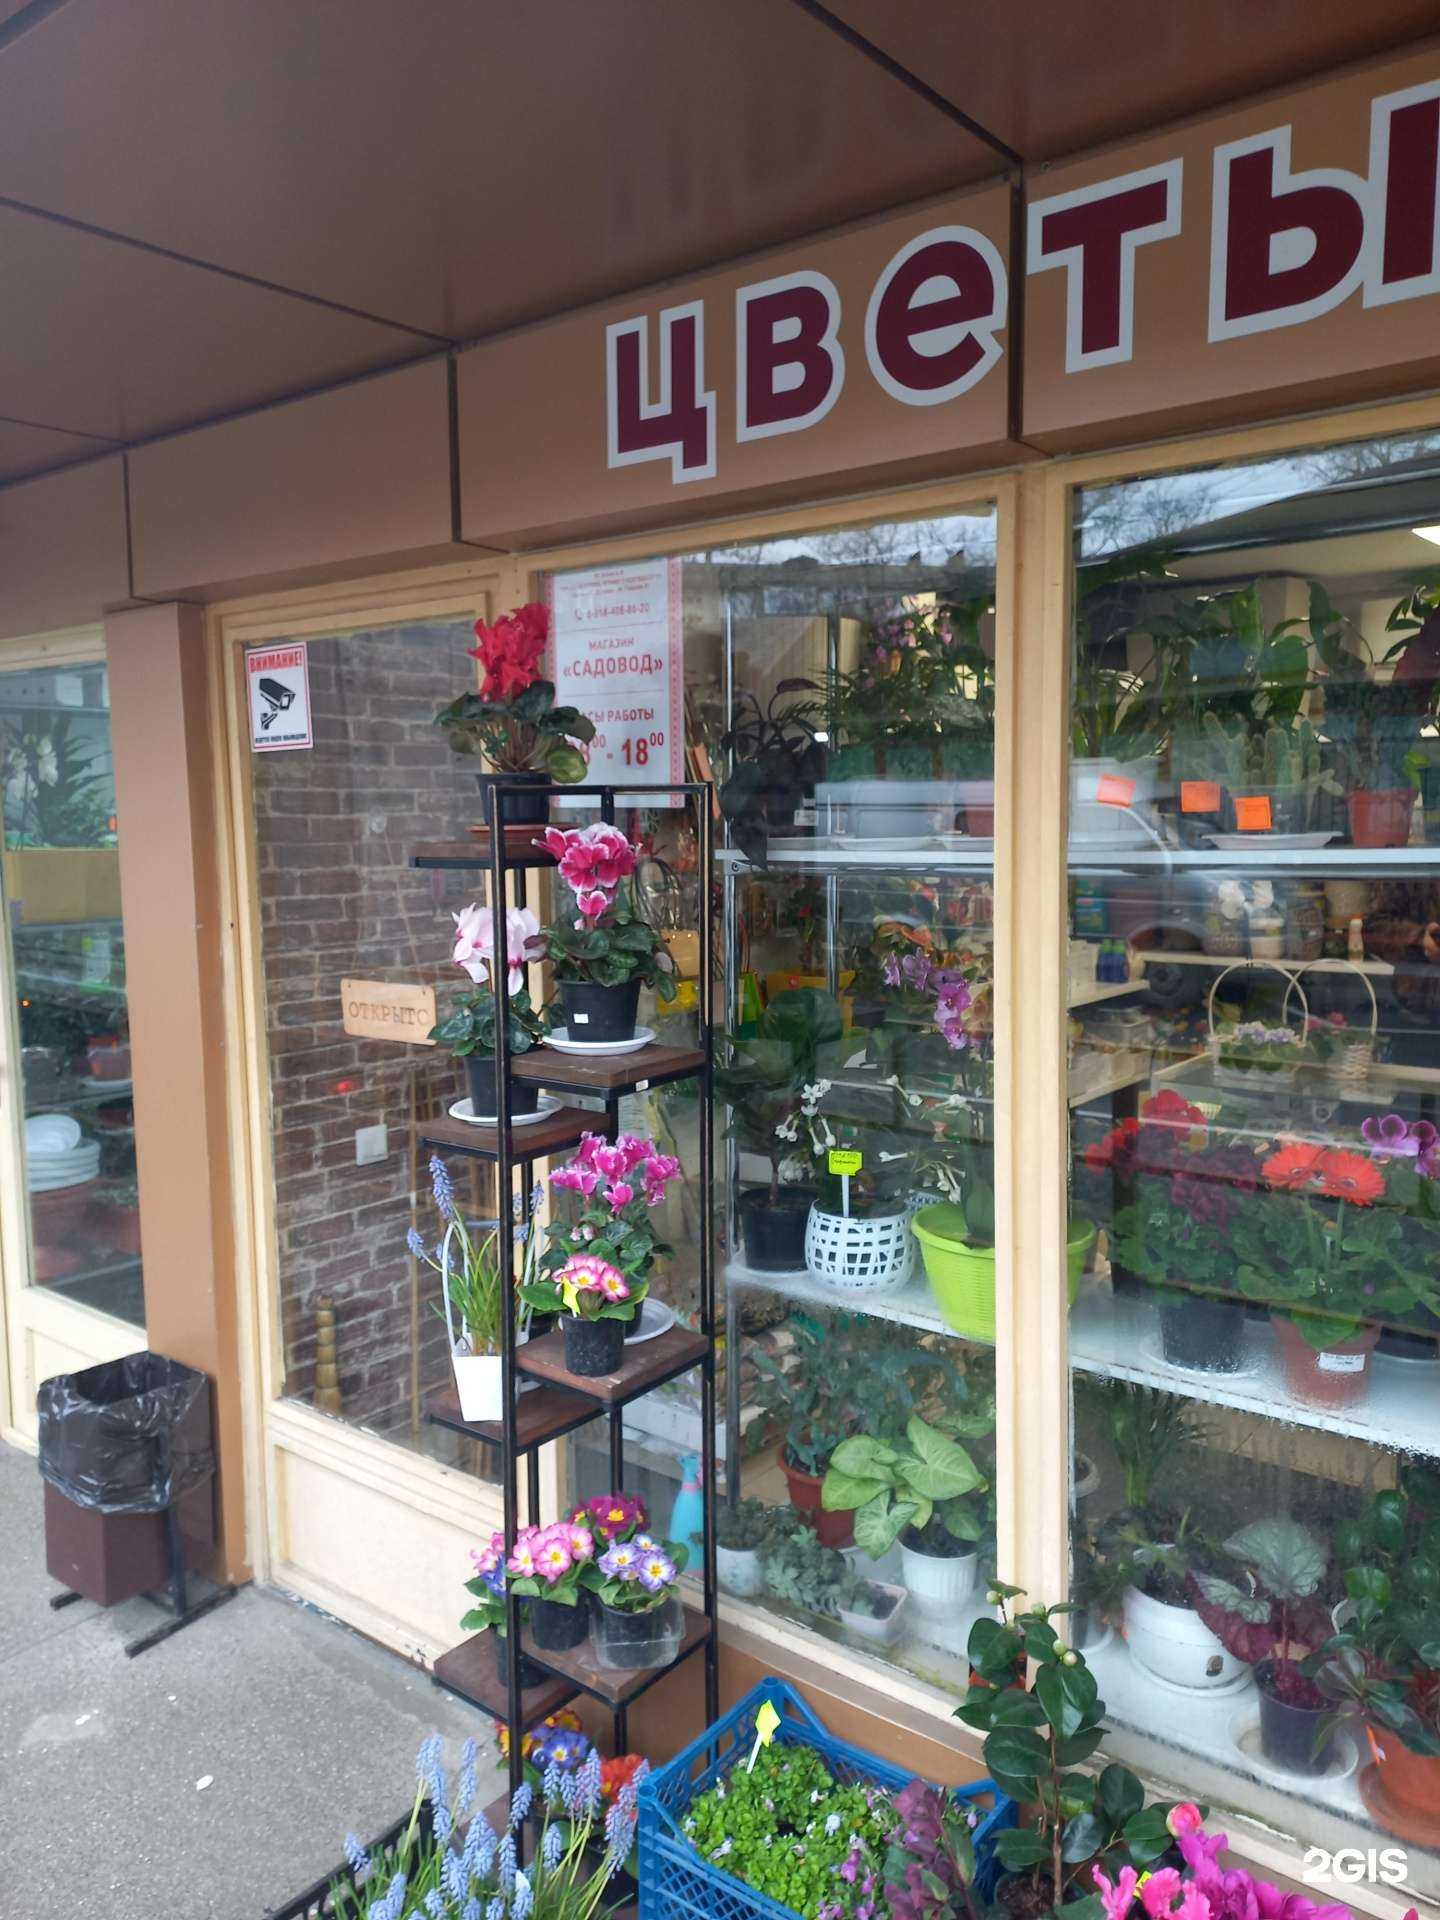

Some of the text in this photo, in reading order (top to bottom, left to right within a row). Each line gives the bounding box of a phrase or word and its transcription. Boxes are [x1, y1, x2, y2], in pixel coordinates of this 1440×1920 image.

[588, 637, 635, 651] МАГАЗИН
[563, 654, 663, 679] «САДОВОД»
[607, 707, 655, 722] РАБОТЫ
